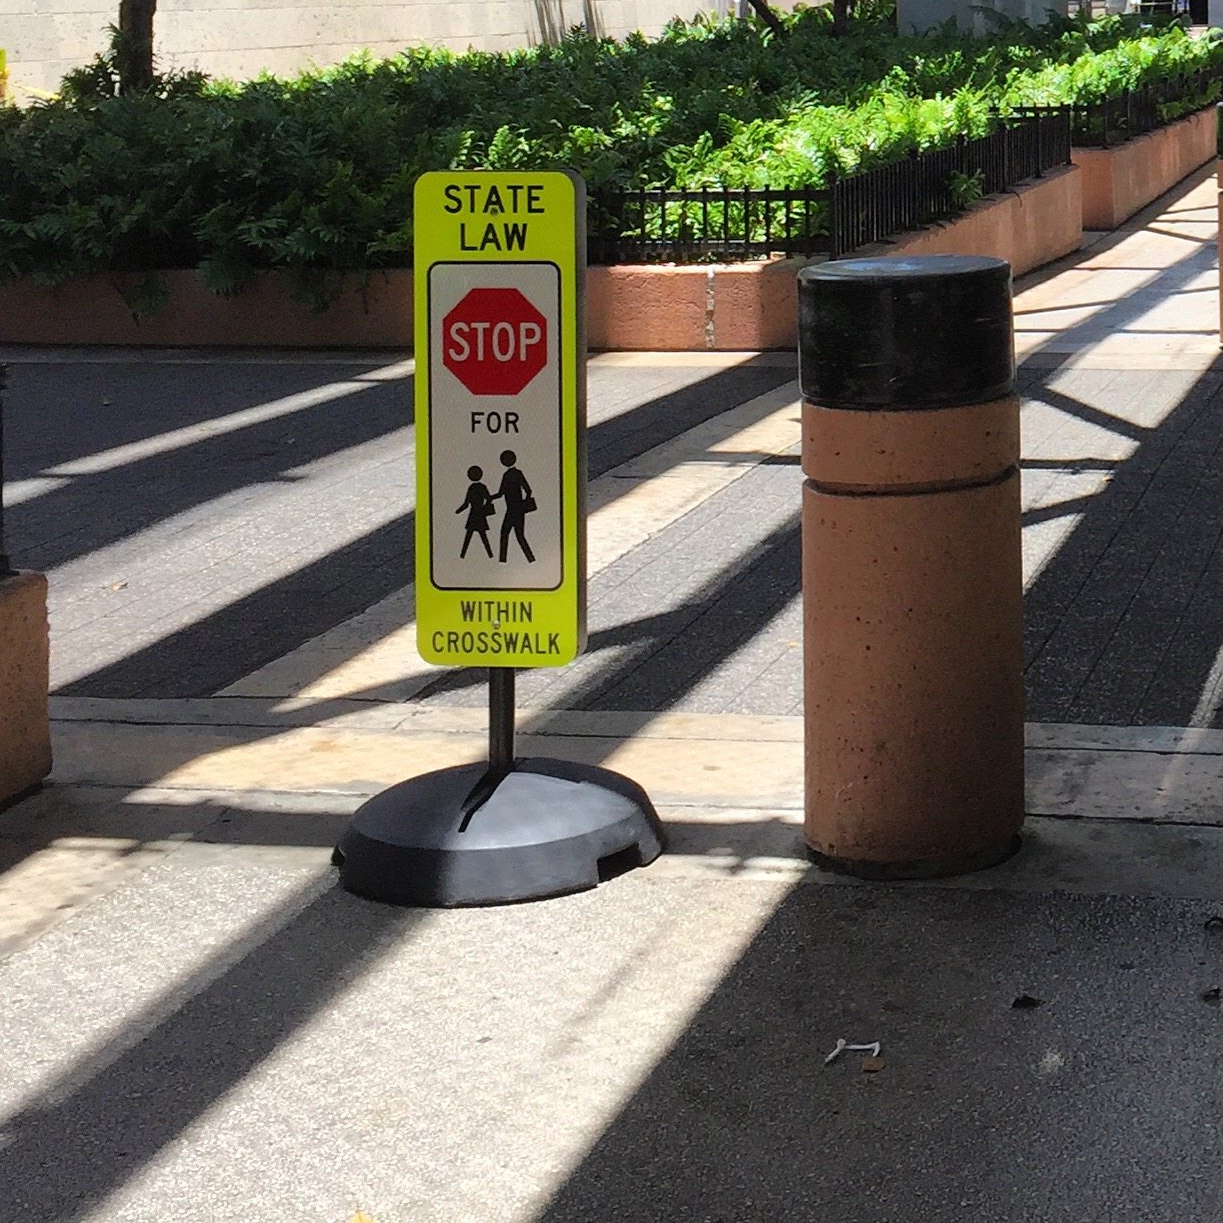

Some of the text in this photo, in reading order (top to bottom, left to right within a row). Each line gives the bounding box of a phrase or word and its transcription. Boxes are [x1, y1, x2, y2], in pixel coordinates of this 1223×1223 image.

[443, 185, 545, 214] STATE
[460, 223, 527, 251] LAW
[449, 322, 542, 362] STOP
[471, 412, 520, 433] FOR
[461, 601, 532, 623] WITHIN
[432, 631, 560, 655] CROSSWALK
